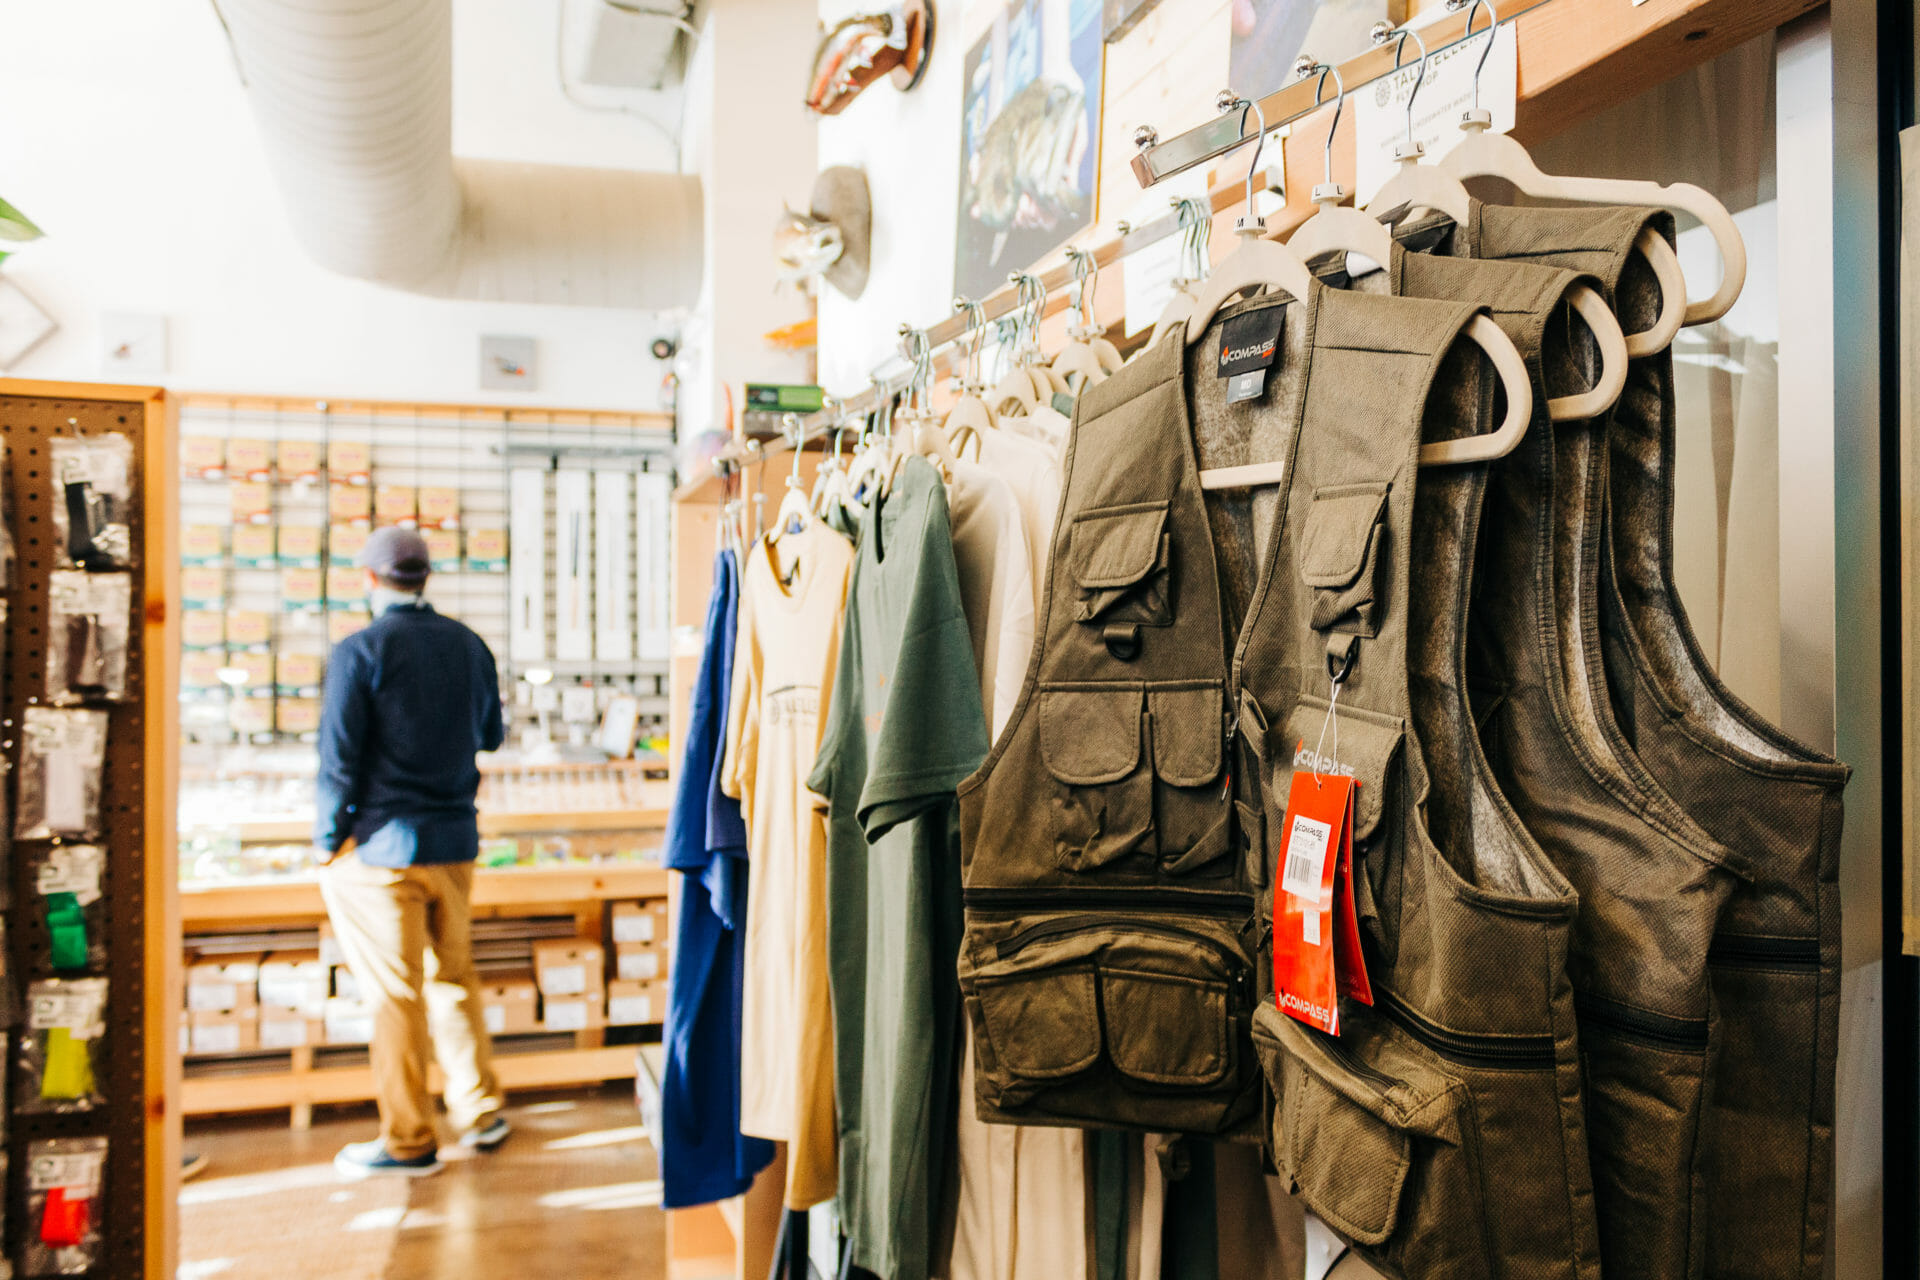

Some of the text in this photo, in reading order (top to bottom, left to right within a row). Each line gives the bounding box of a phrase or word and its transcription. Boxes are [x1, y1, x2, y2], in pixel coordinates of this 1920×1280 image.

[1257, 216, 1265, 227] M
[1228, 337, 1275, 362] COMPASS
[1300, 748, 1355, 776] COMPASS
[1285, 993, 1330, 1023] COMPASS
